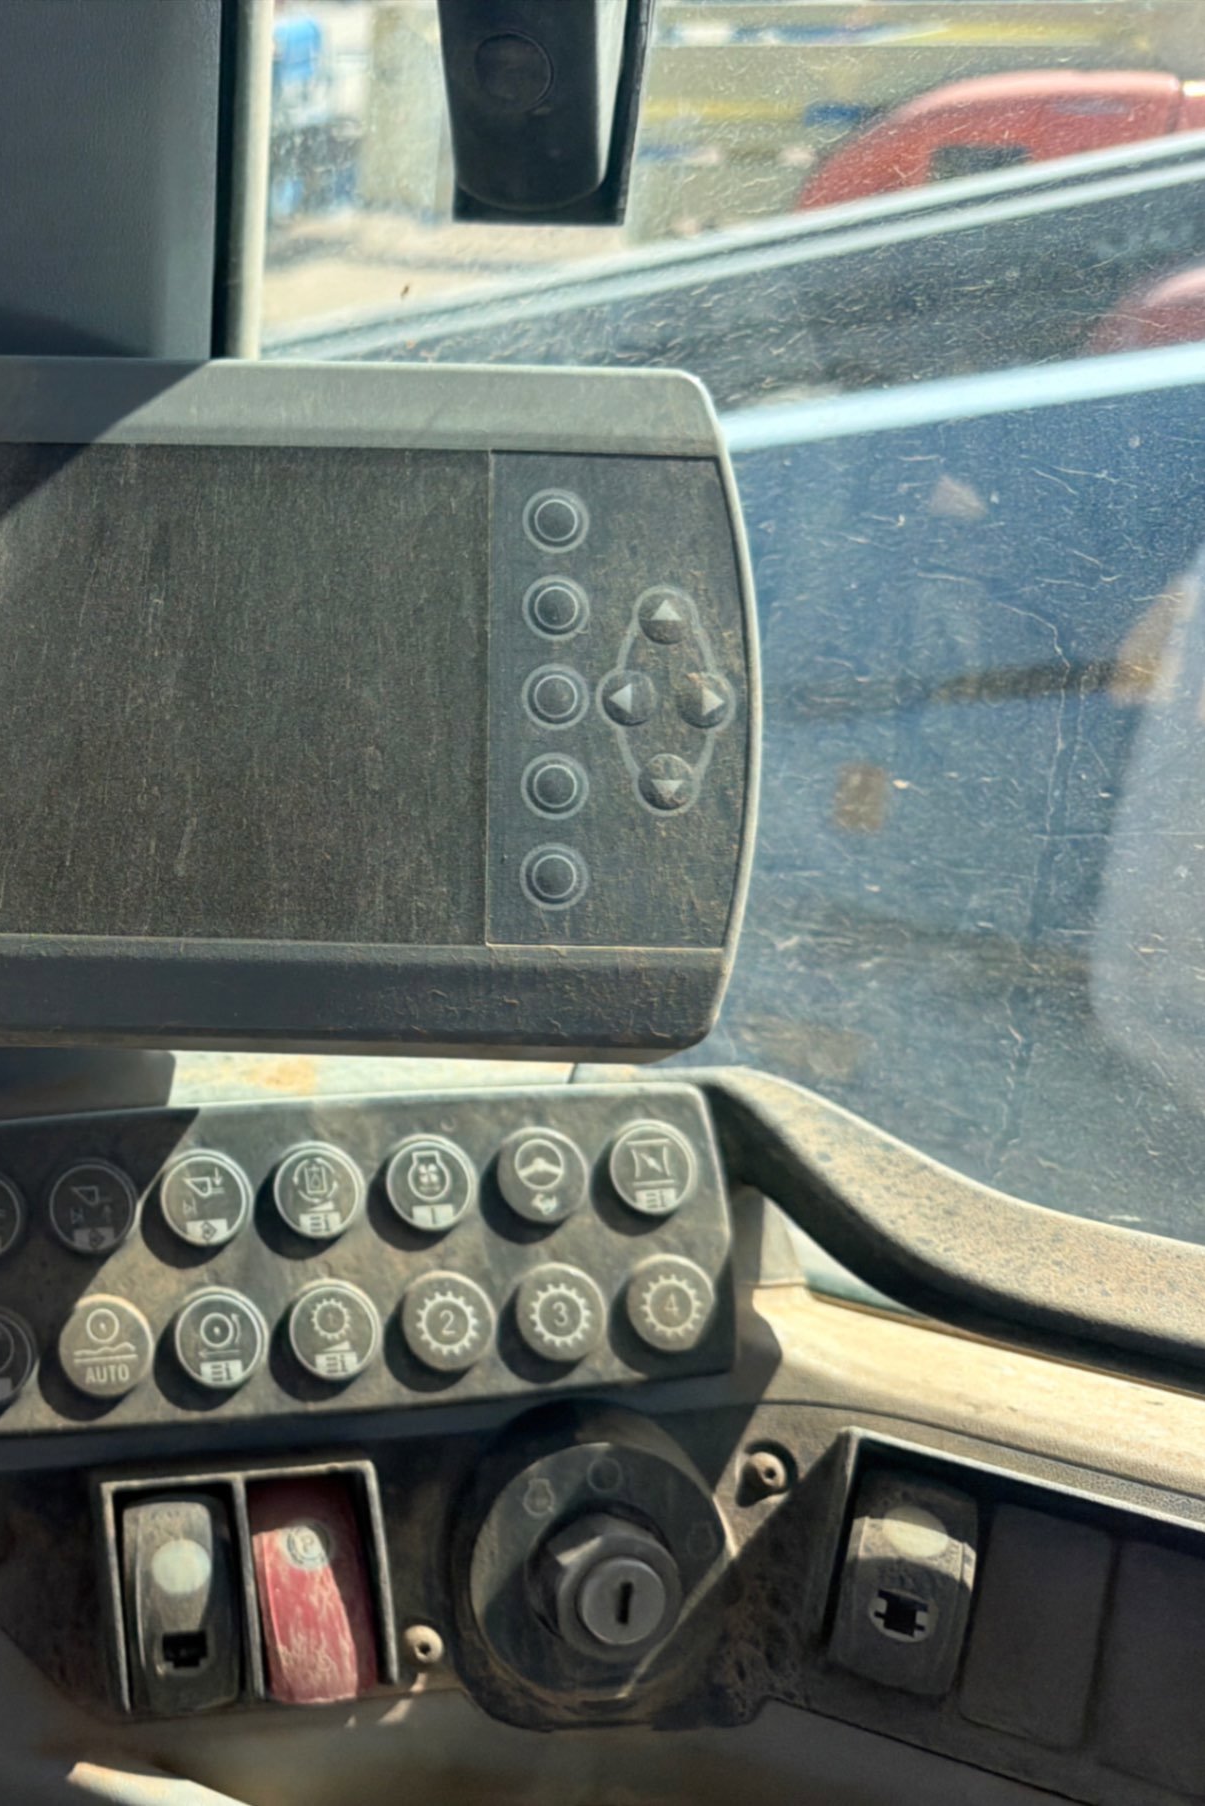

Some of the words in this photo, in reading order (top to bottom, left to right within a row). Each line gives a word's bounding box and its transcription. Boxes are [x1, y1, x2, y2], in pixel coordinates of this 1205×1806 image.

[552, 1301, 569, 1327] 3
[664, 1292, 679, 1316] 4
[439, 1308, 457, 1336] 2
[85, 1363, 131, 1385] AUTO
